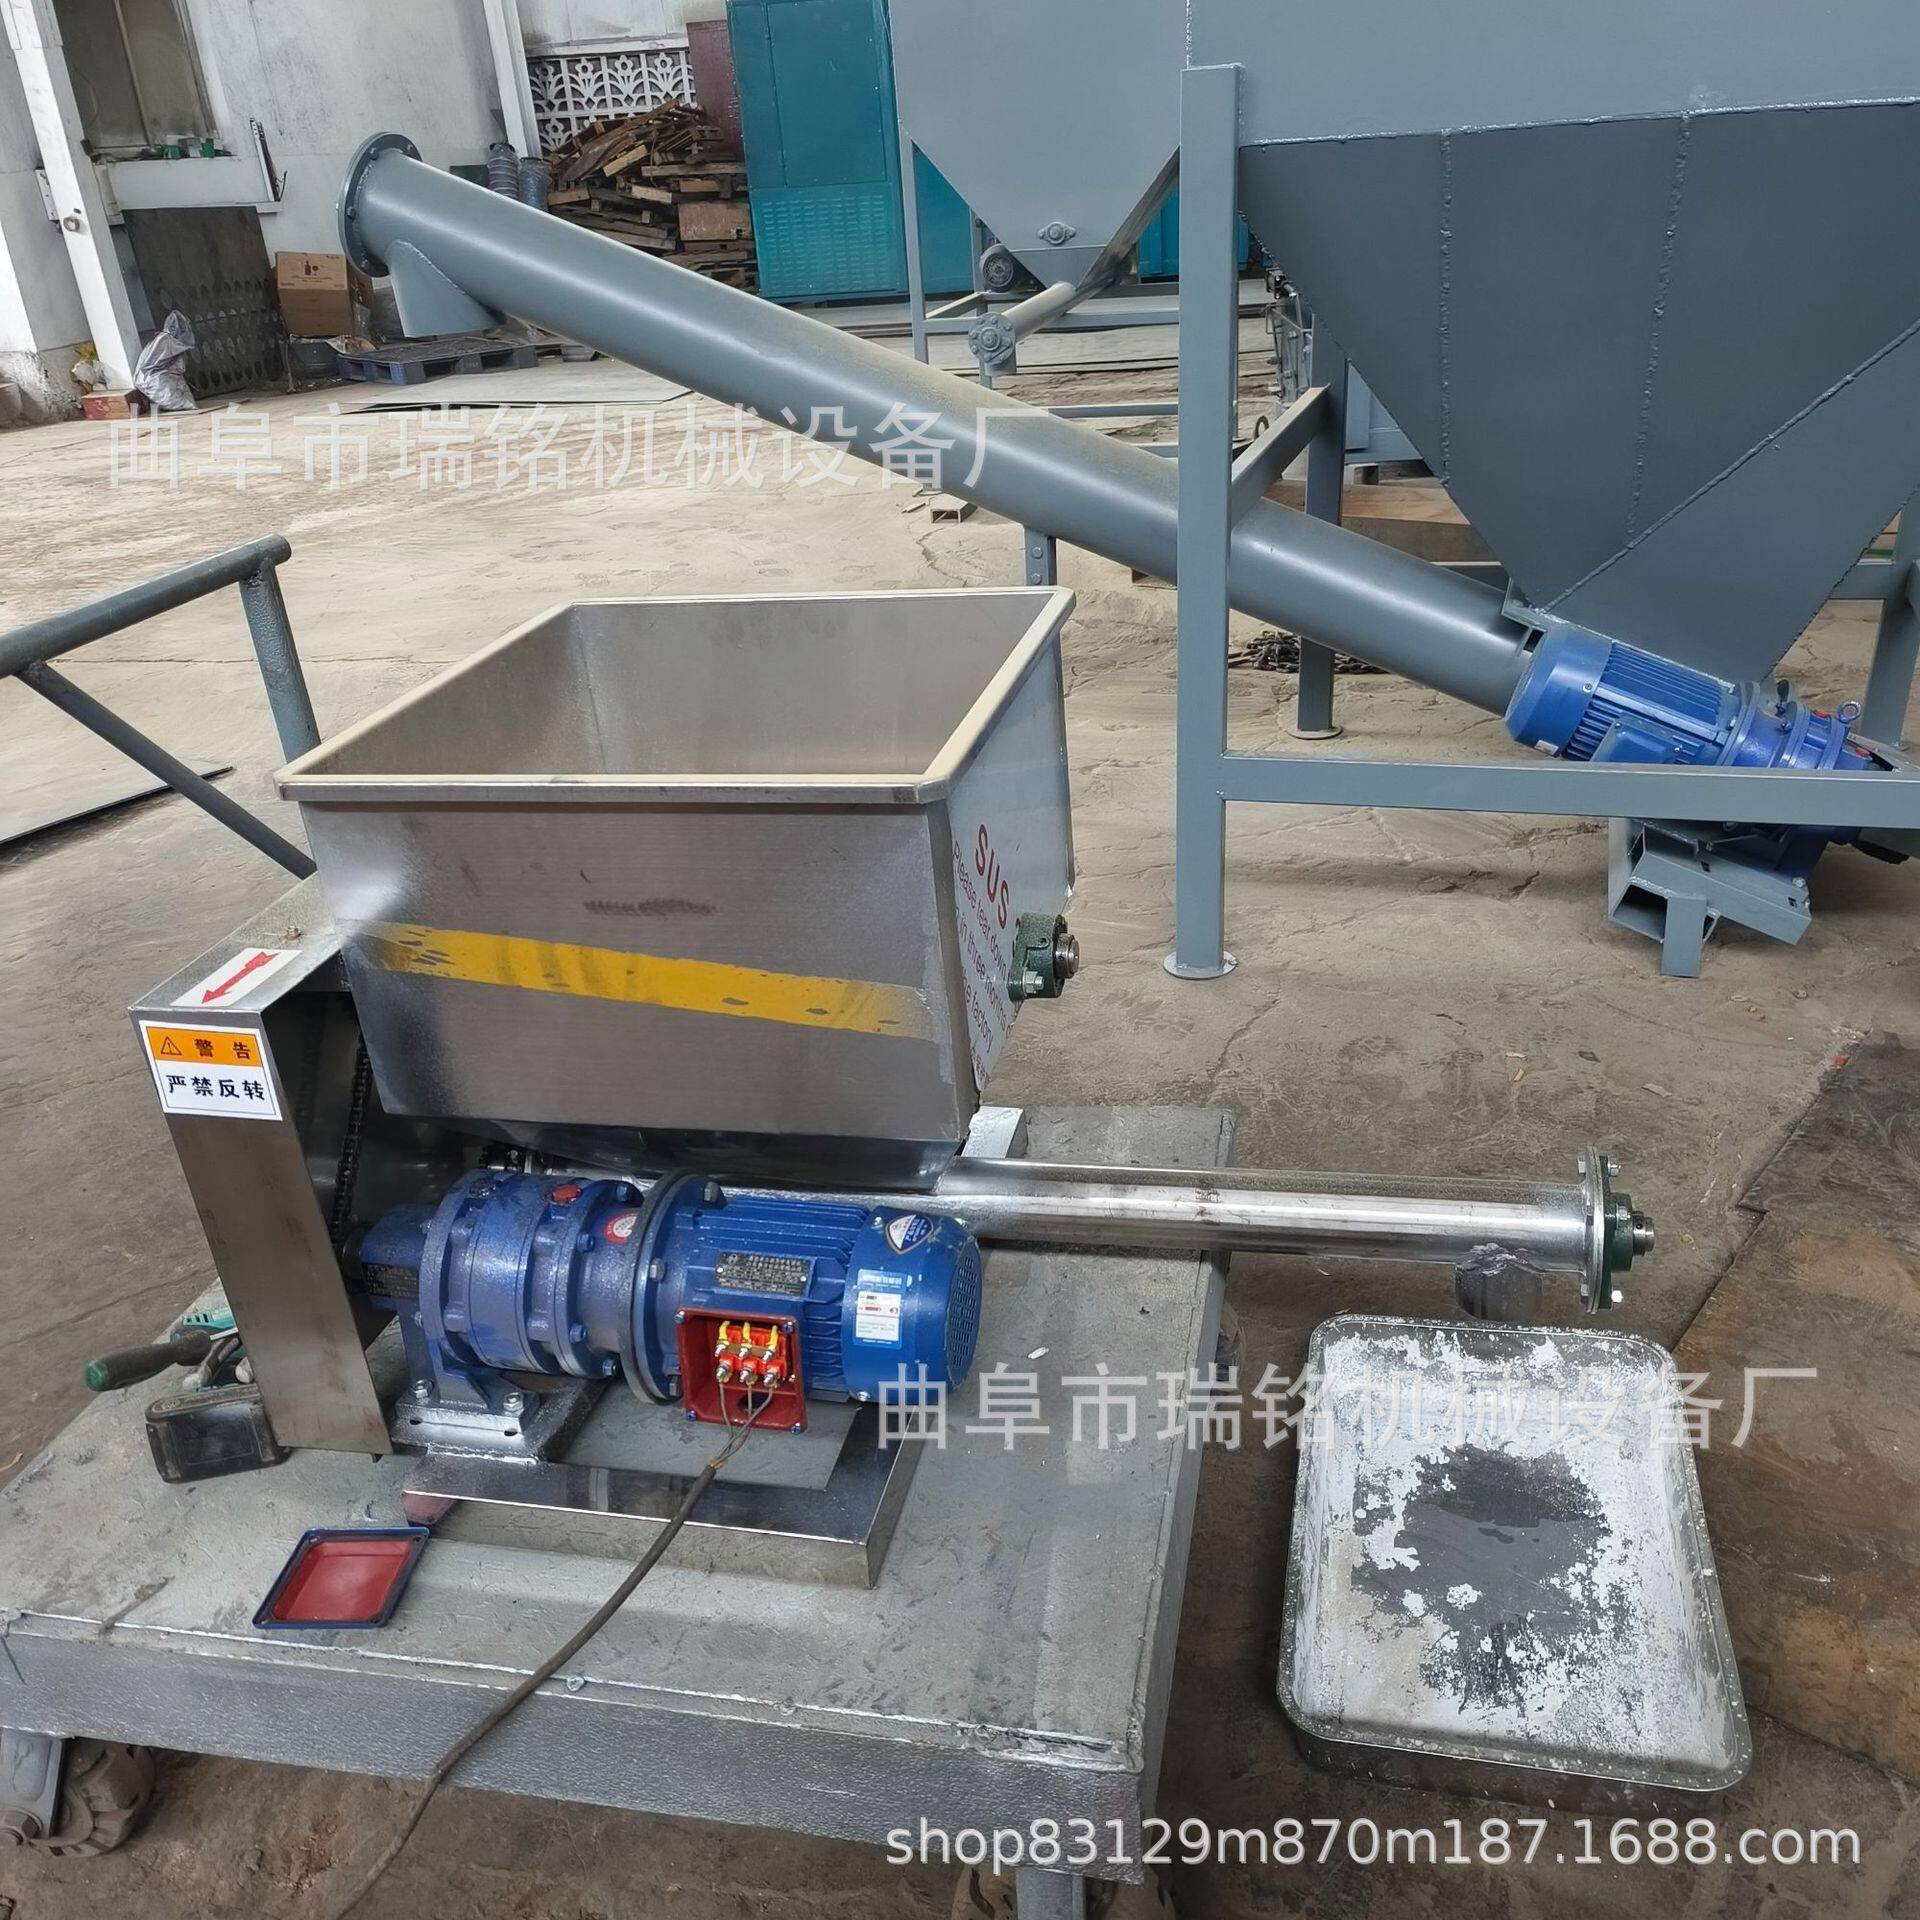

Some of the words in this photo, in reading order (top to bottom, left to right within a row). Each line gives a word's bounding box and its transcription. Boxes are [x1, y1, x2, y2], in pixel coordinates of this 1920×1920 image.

[953, 841, 977, 909] Please
[976, 899, 991, 941] tear
[989, 934, 1008, 981] down
[967, 930, 986, 980] three
[985, 976, 1007, 1032] months
[193, 1037, 251, 1061] 警告
[971, 990, 995, 1054] factory
[165, 1074, 266, 1101] 严禁反转
